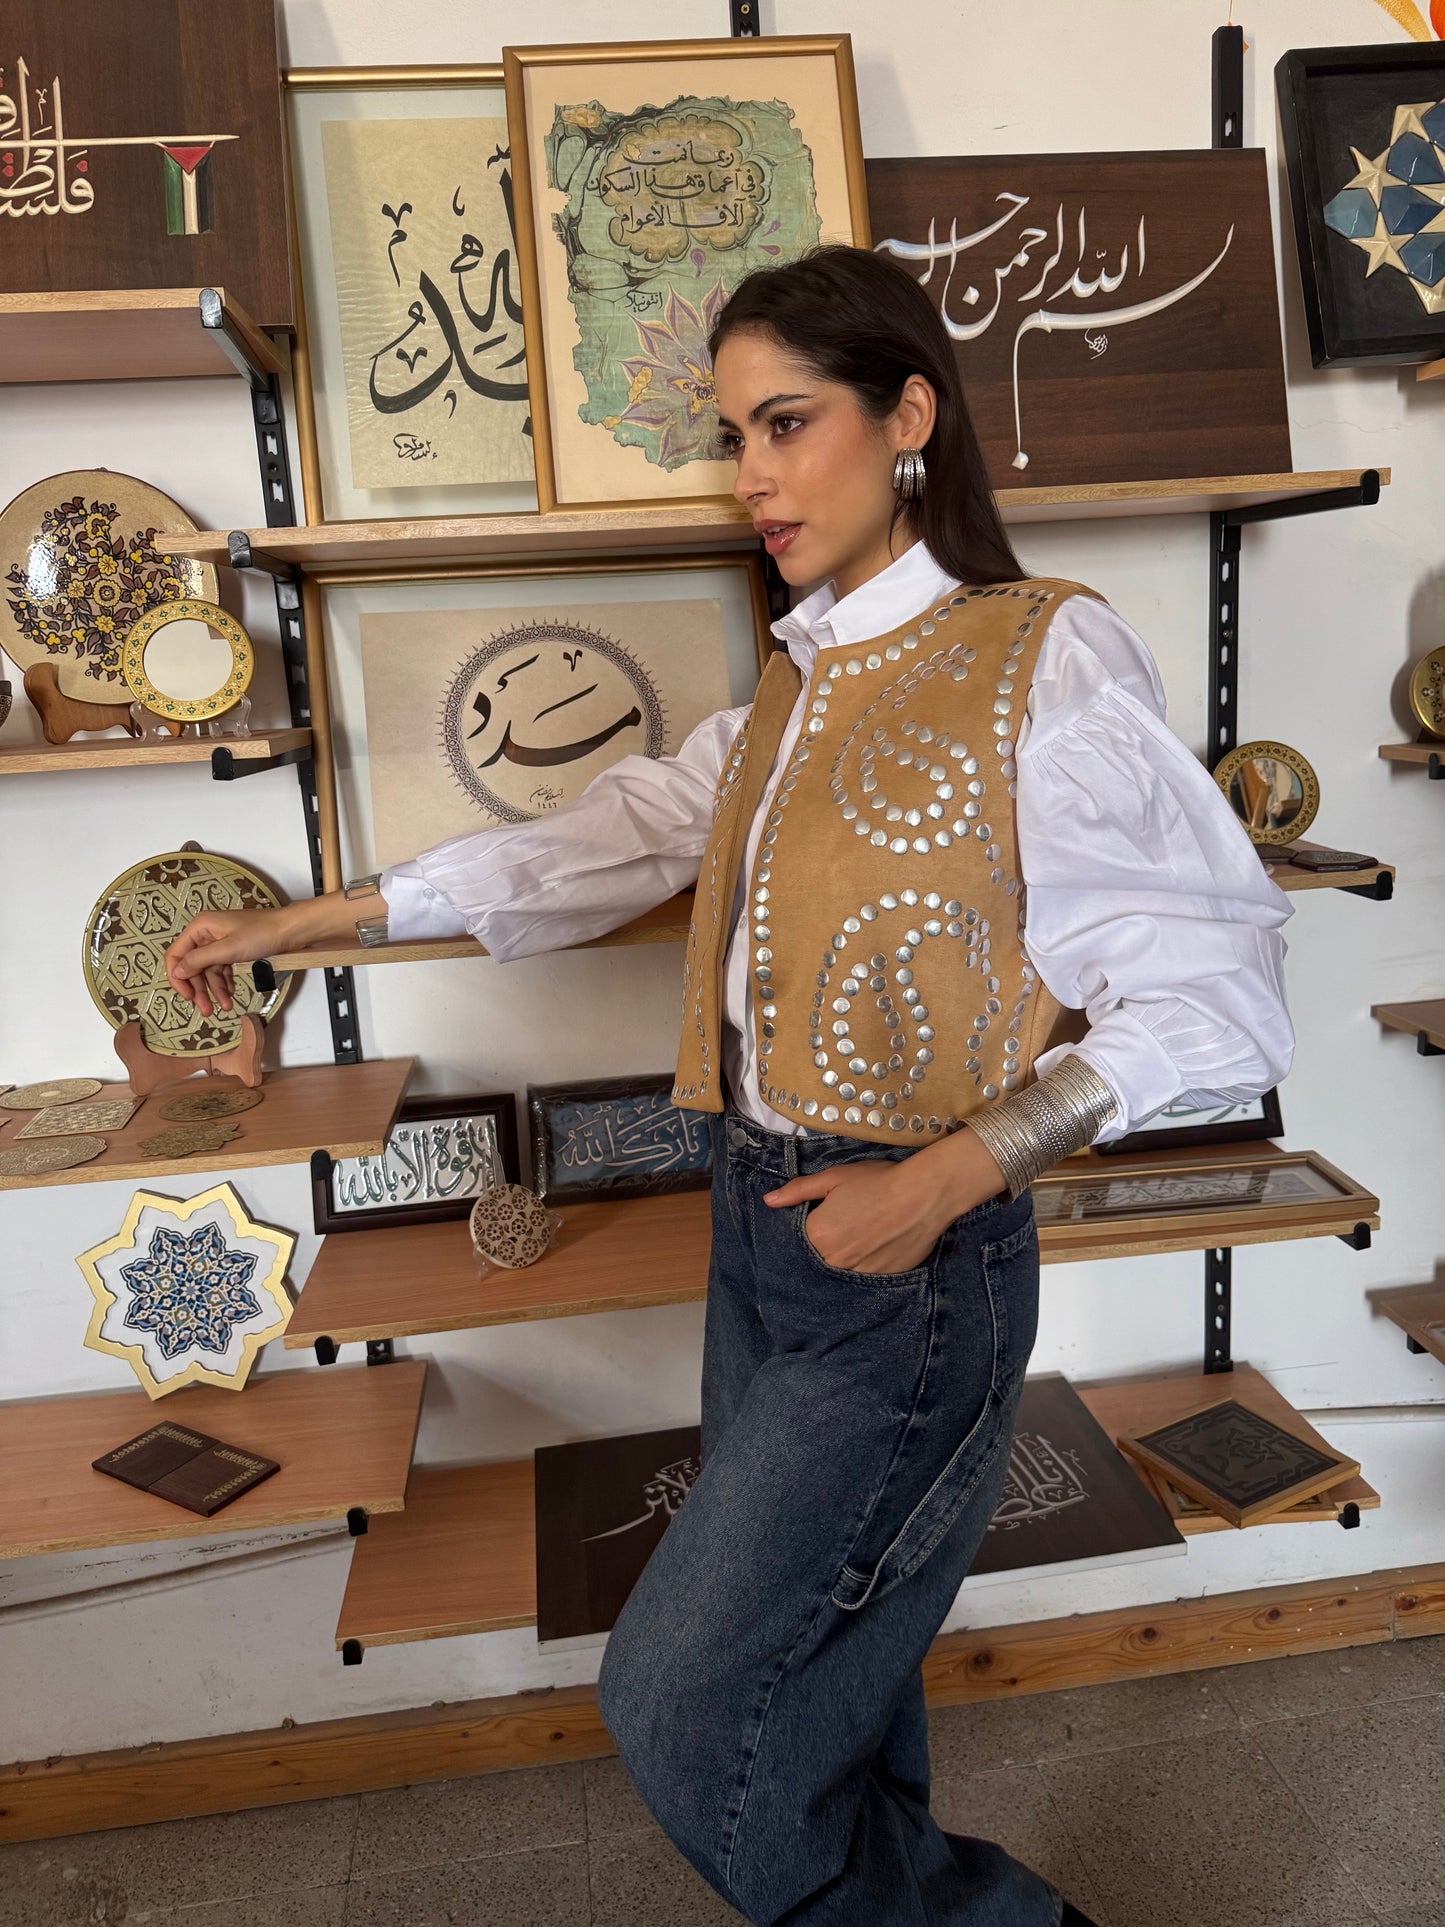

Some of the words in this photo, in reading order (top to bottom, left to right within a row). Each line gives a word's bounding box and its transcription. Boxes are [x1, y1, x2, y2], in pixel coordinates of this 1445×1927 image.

[690, 140, 735, 168] ربما
[644, 167, 696, 189] هذا
[740, 168, 757, 198] في
[557, 1112, 616, 1168] الله
